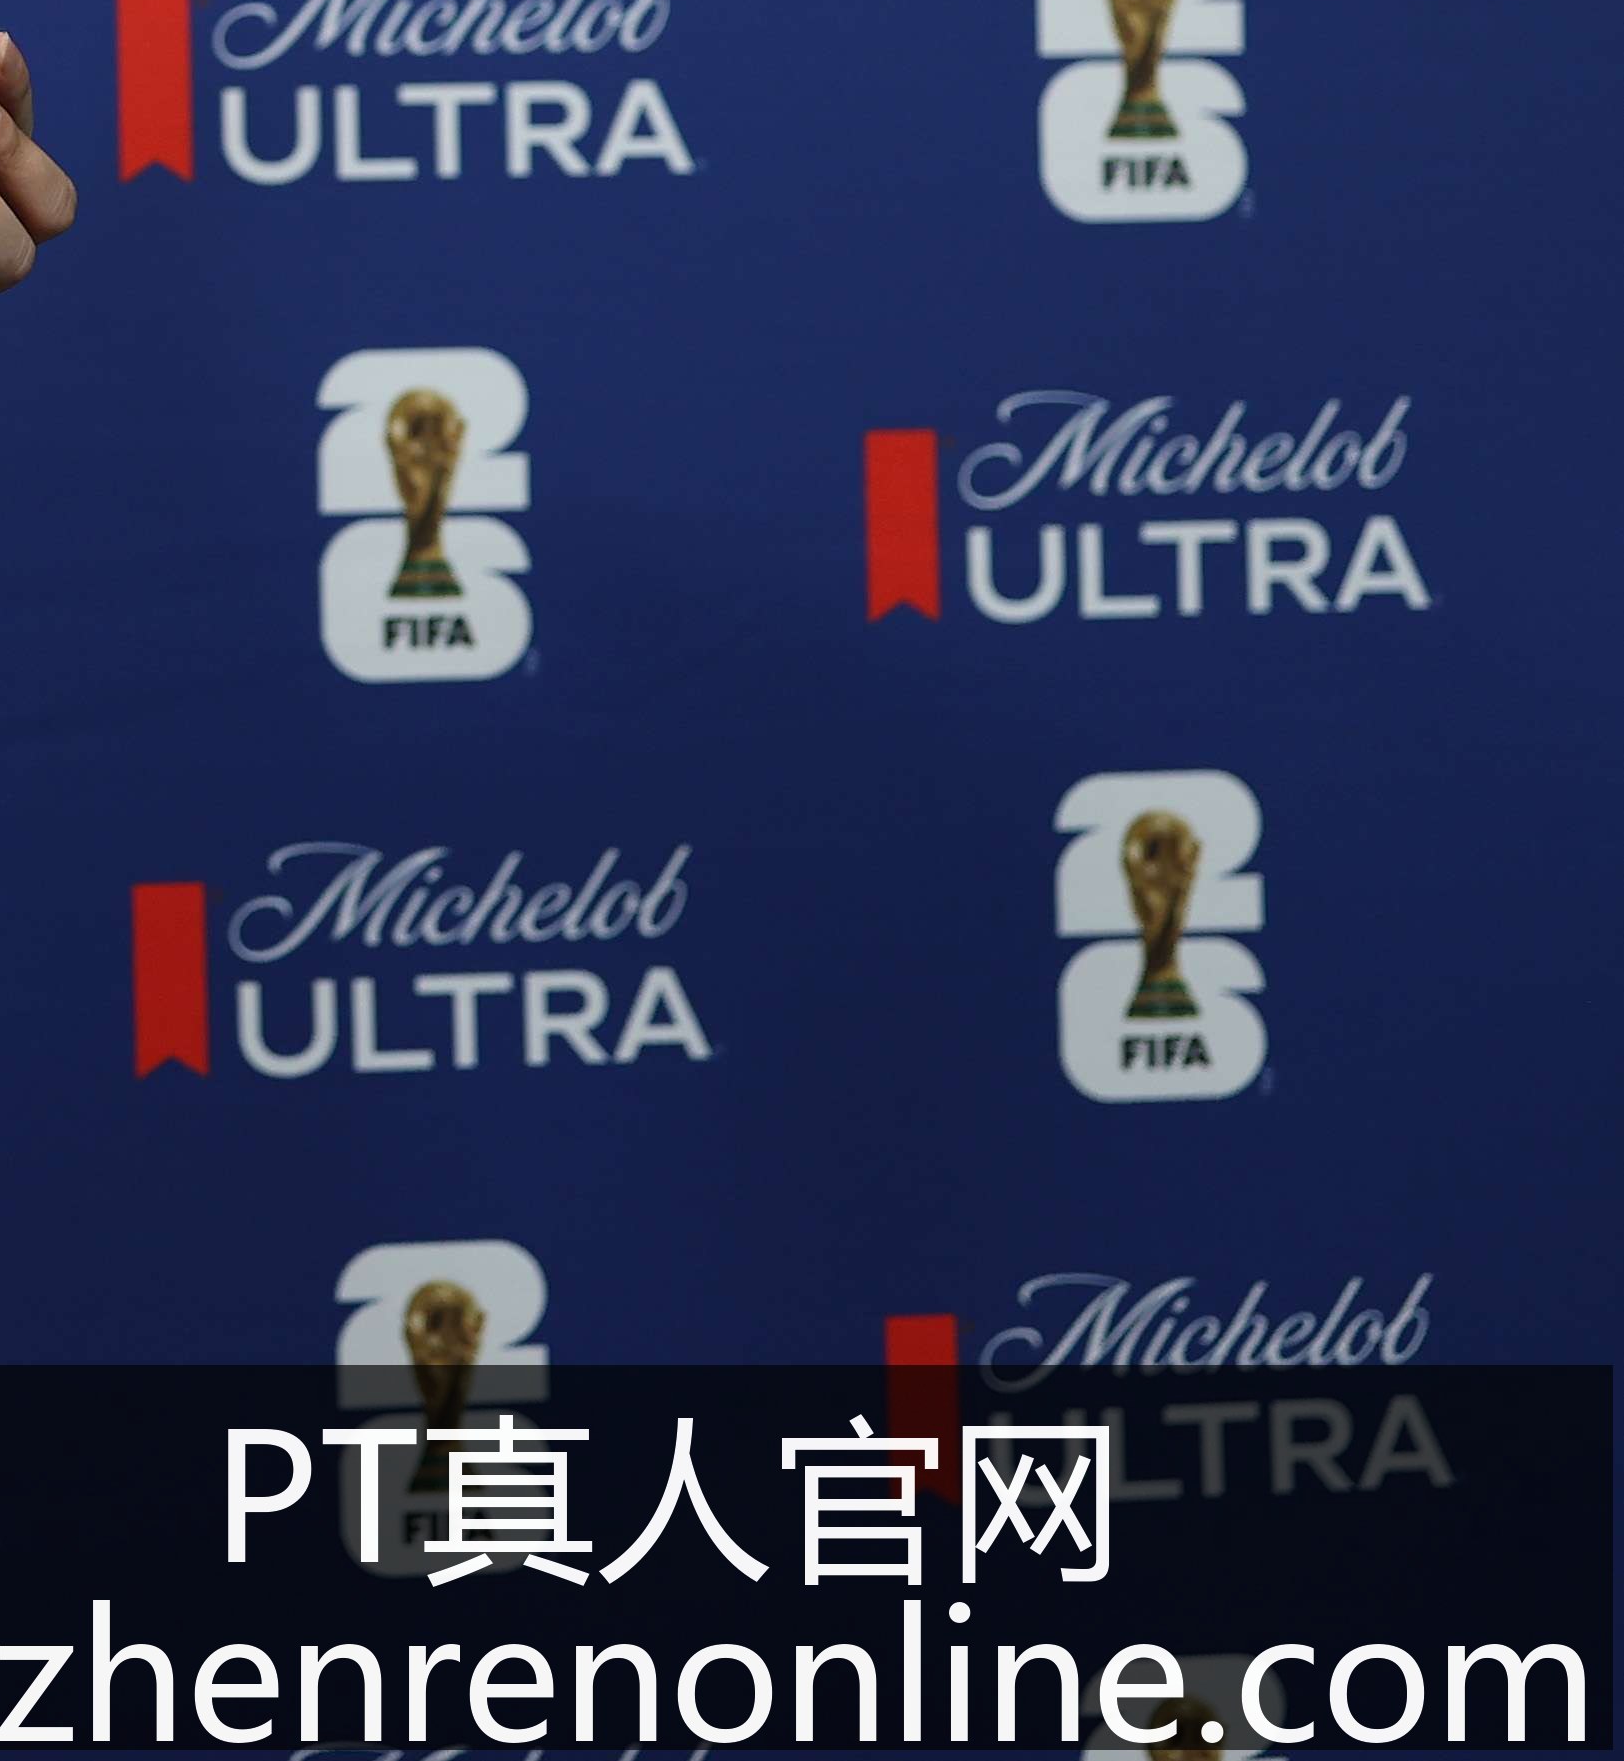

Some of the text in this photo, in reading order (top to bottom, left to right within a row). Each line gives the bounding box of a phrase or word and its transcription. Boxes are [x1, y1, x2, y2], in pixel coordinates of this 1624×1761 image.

[222, 80, 693, 184] ULTRA
[1103, 158, 1189, 187] FIFA
[960, 391, 1409, 509] Michelob
[967, 516, 1429, 622] ULTRA
[385, 616, 472, 648] FIFA
[230, 843, 689, 961] Michelob
[238, 967, 710, 1077] ULTRA
[1122, 1036, 1209, 1068] FIFA
[979, 1272, 1433, 1393] Michelob
